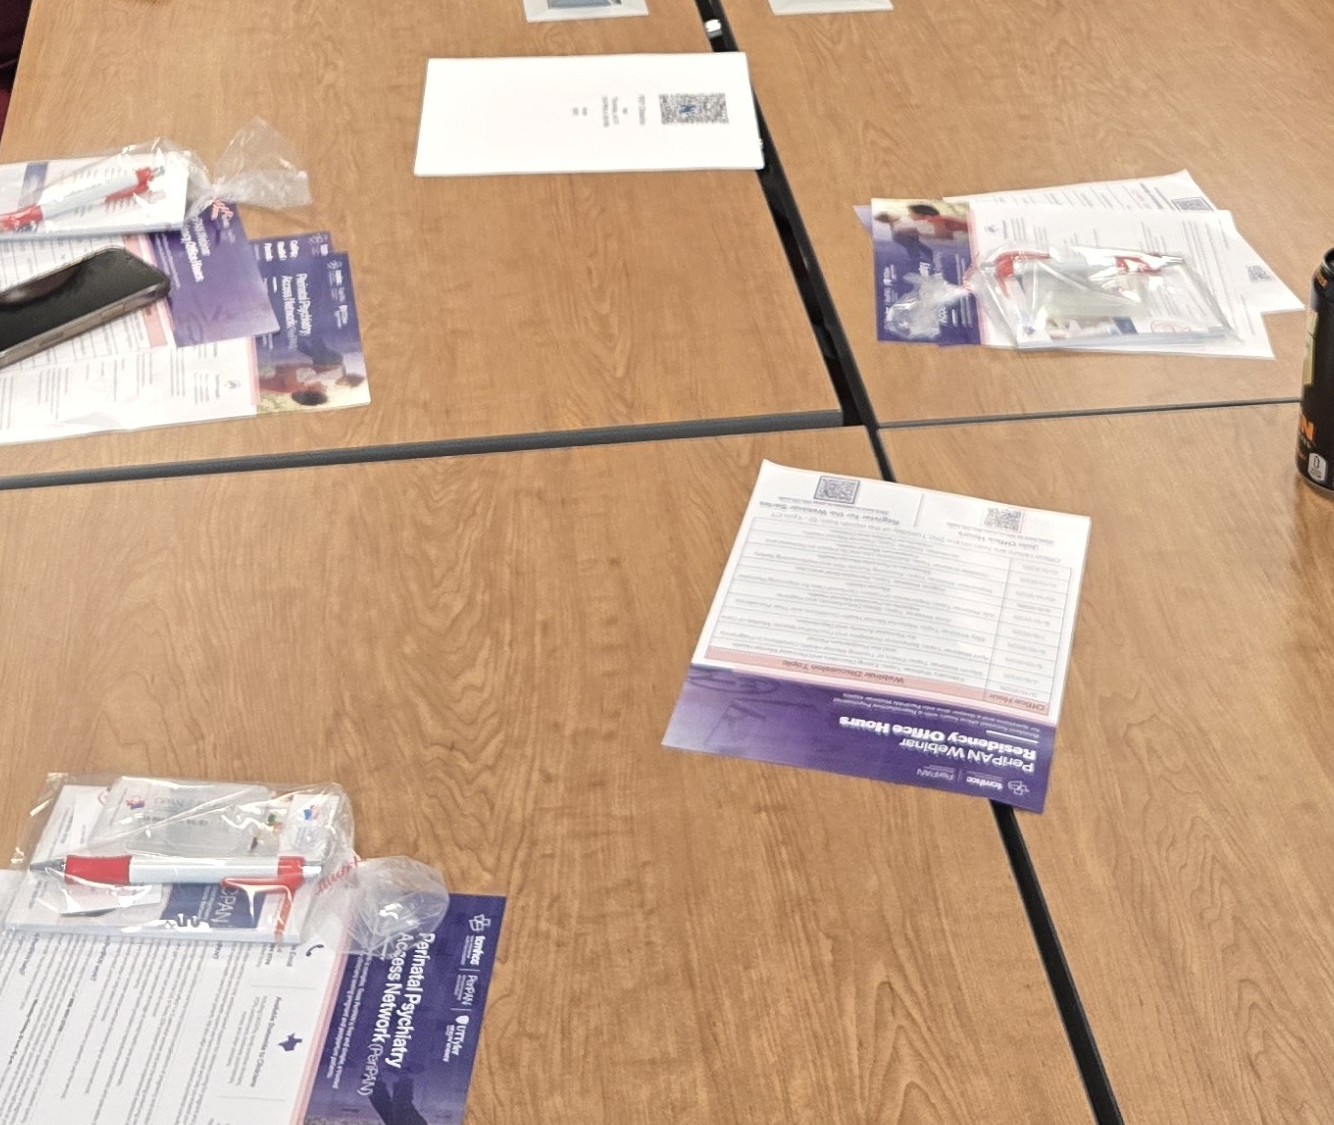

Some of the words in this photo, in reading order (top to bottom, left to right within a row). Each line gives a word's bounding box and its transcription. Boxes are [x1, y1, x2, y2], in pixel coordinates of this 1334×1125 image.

[780, 658, 809, 670] Topic
[809, 662, 862, 678] Discussion
[862, 670, 904, 684] Webinar
[987, 692, 1013, 704] Hour
[1012, 697, 1045, 711] Office
[836, 714, 891, 733] Hours
[890, 723, 945, 743] Office
[897, 736, 966, 759] Webinar
[945, 730, 1038, 760] Residency
[964, 748, 1035, 772] PeriPAN
[385, 931, 412, 981] Access
[403, 931, 435, 991] Perinatal
[459, 974, 479, 1005] PeriPAN
[369, 982, 401, 1042] Network
[382, 993, 423, 1068] Psychiatry
[354, 1043, 385, 1096] (PeriPAN)
